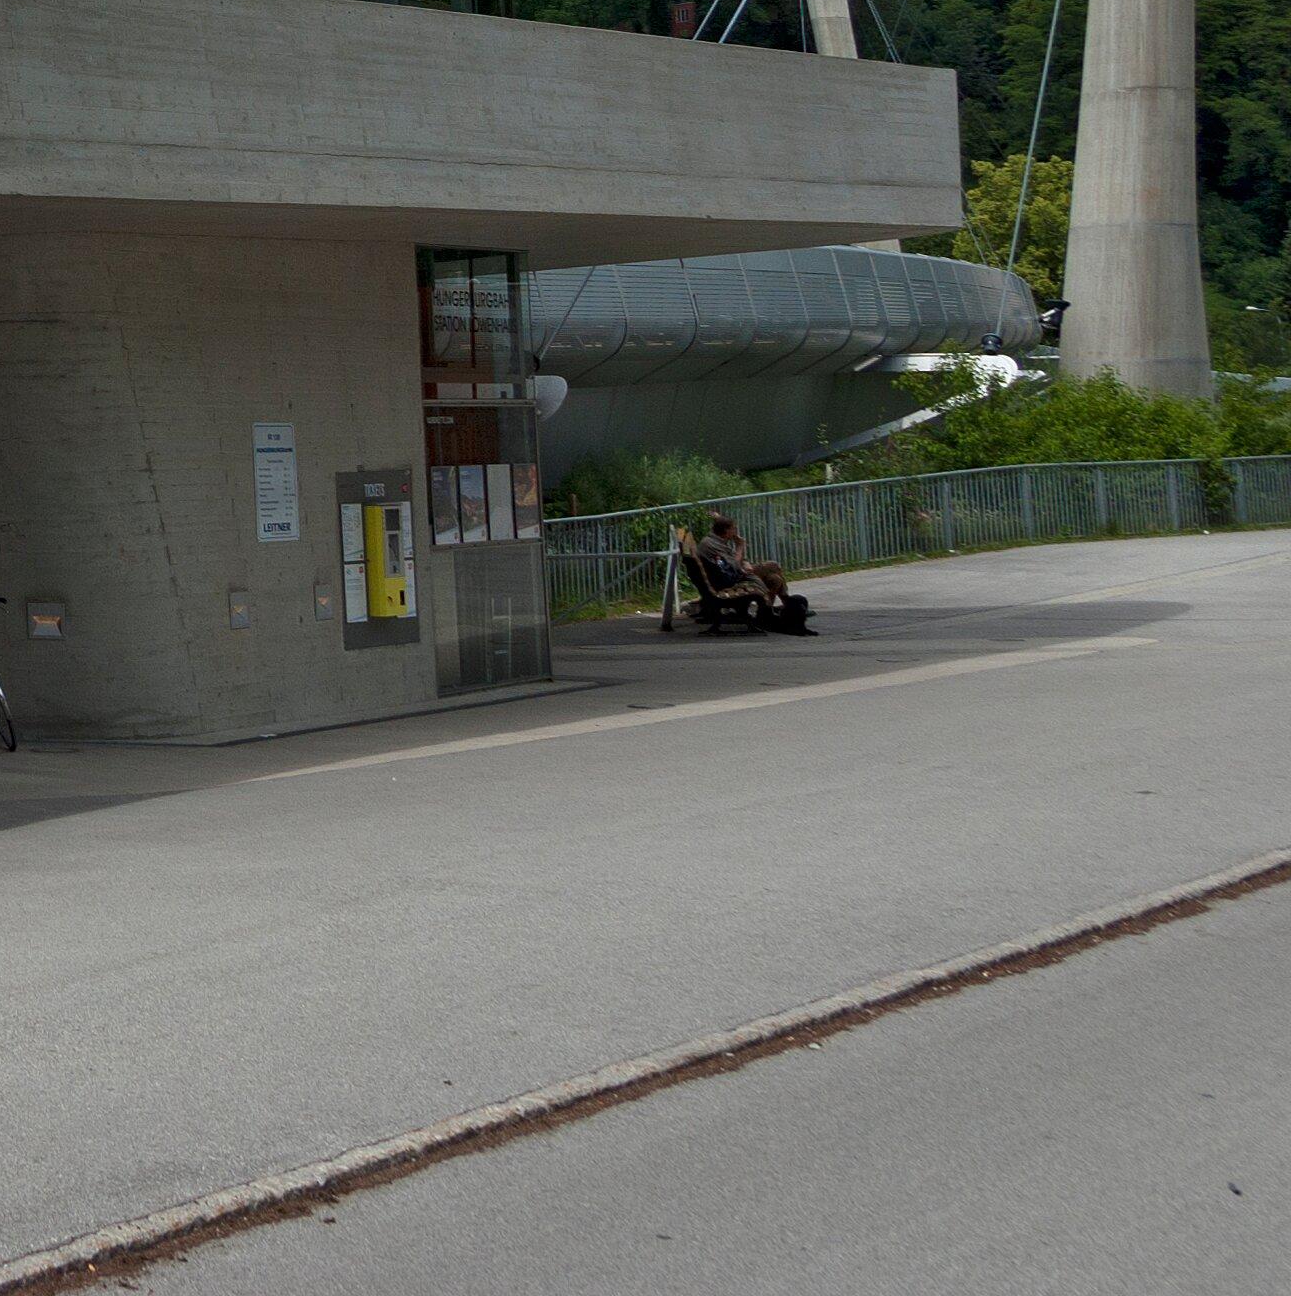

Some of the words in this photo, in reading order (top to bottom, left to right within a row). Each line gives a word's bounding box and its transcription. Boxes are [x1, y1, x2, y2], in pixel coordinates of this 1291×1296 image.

[433, 290, 516, 308] HUNGERURGBAH
[434, 315, 467, 332] STATION
[263, 521, 292, 533] LEITNER
